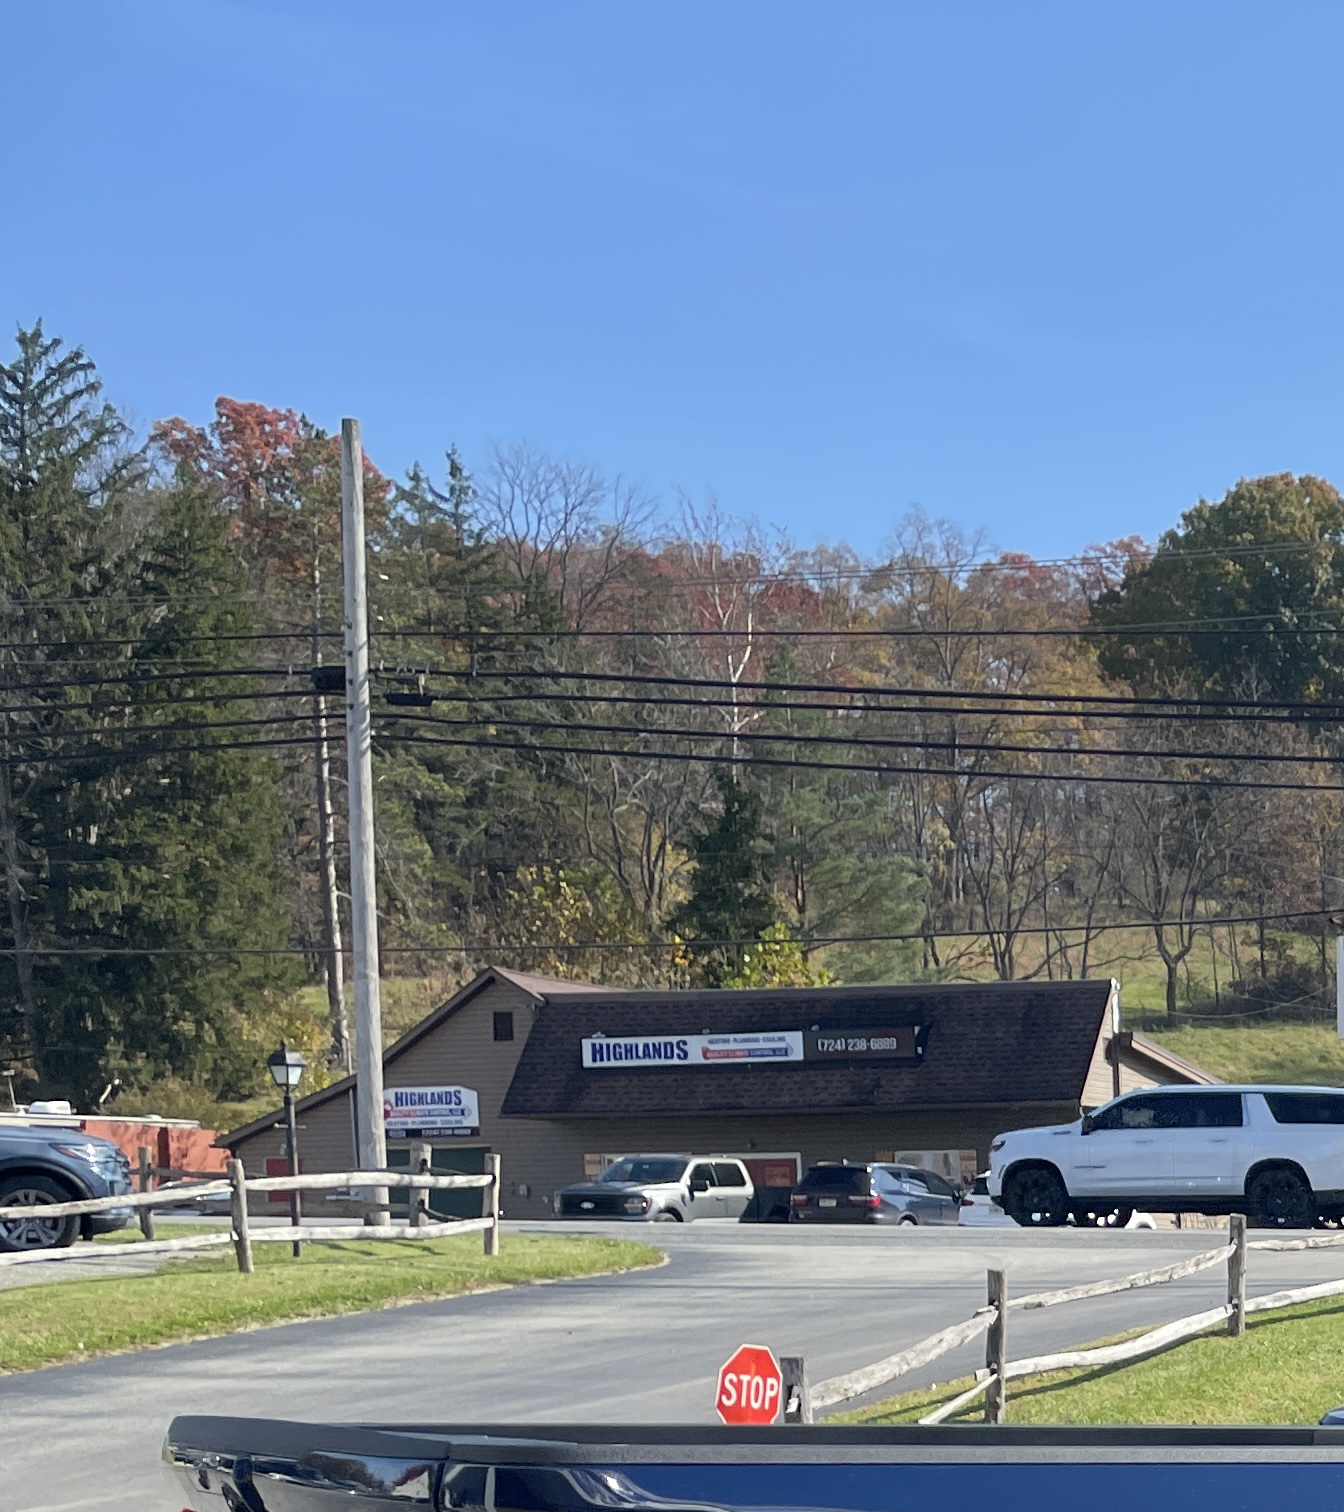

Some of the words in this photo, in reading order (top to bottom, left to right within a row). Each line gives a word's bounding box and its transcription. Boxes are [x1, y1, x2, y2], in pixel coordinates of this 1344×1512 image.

[591, 1040, 689, 1062] HIGHLANDS
[817, 1038, 845, 1052] (724)
[394, 1089, 462, 1107] HIGHLANDS
[721, 1372, 778, 1411] STOP
